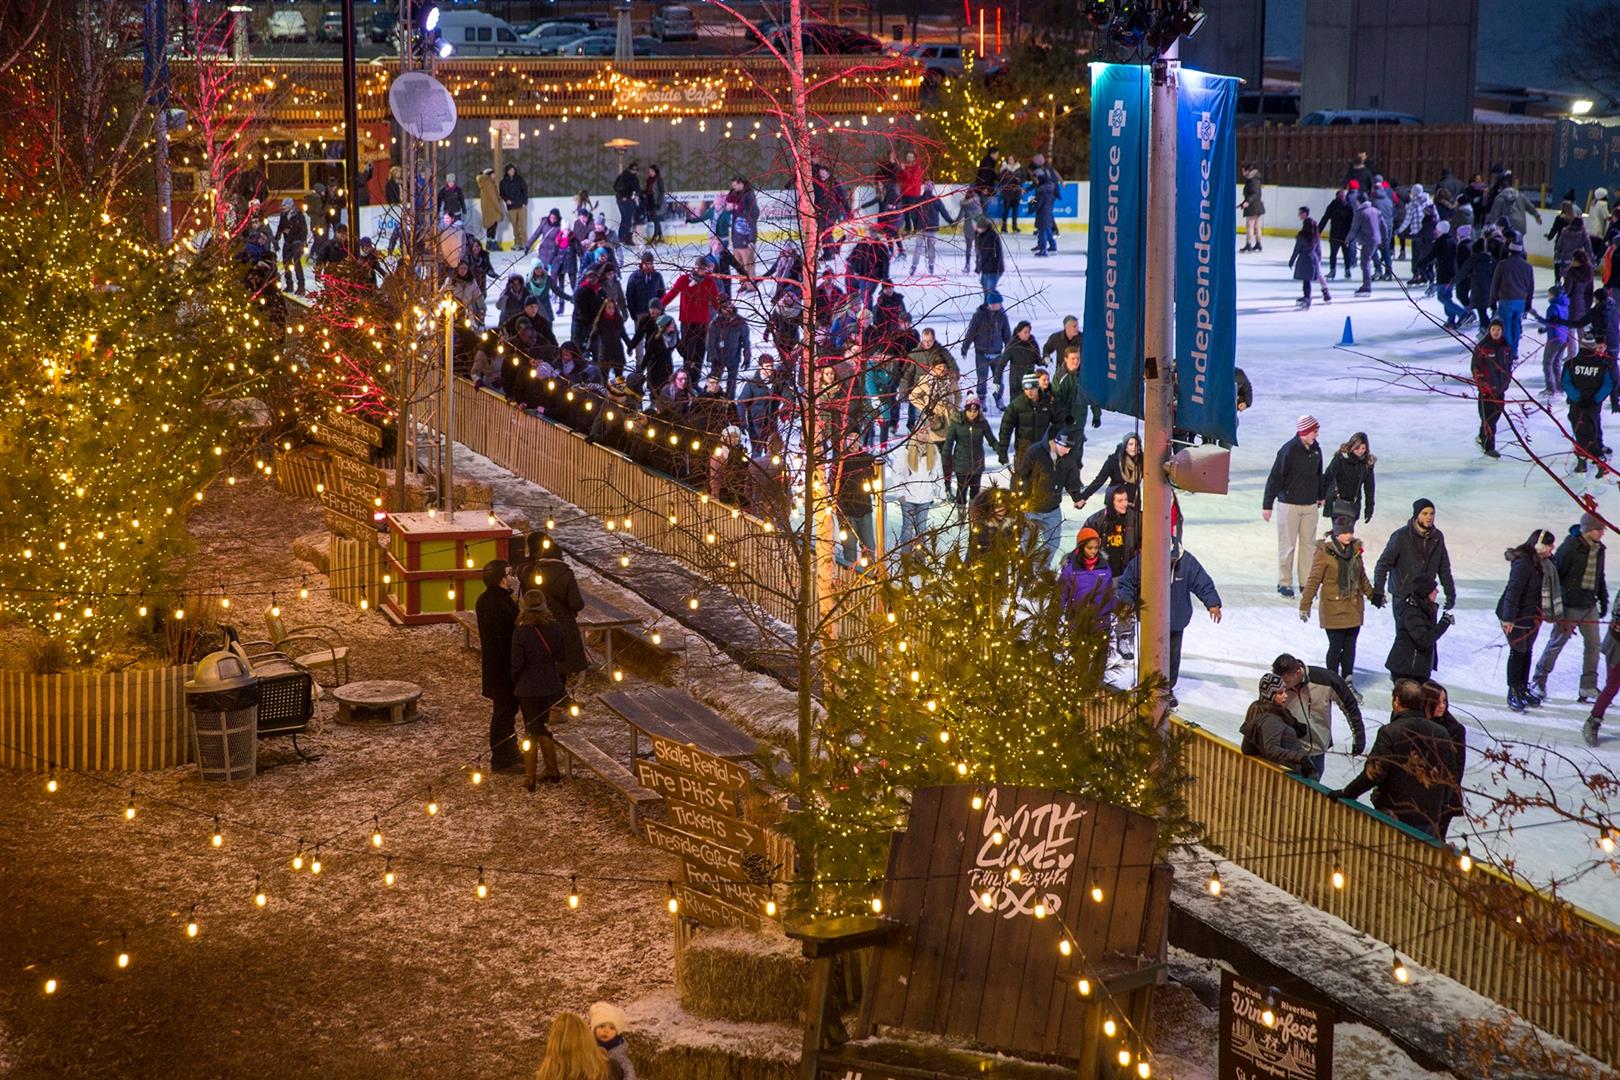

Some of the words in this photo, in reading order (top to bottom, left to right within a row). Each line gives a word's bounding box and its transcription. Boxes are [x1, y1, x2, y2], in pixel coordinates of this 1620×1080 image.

[620, 87, 682, 103] Fireside
[1104, 145, 1121, 380] Independence
[1190, 159, 1211, 405] Independence
[1574, 365, 1599, 376] STAFF
[335, 454, 367, 479] Tickets
[329, 493, 349, 512] Fire
[349, 501, 368, 520] Pits
[655, 740, 691, 769] Skate
[691, 751, 729, 785] Rental
[638, 764, 676, 793] Fire
[679, 777, 716, 807] Pits
[671, 806, 727, 838] Tickets
[983, 787, 1088, 850] WITH
[686, 862, 720, 894] Food
[719, 876, 759, 909] Truck
[968, 868, 1068, 888] PHILAELPHIA
[683, 890, 720, 921] River
[968, 886, 1062, 919] XOXO
[1231, 991, 1318, 1044] Winrfest
[1281, 1001, 1317, 1020] RiverRink
